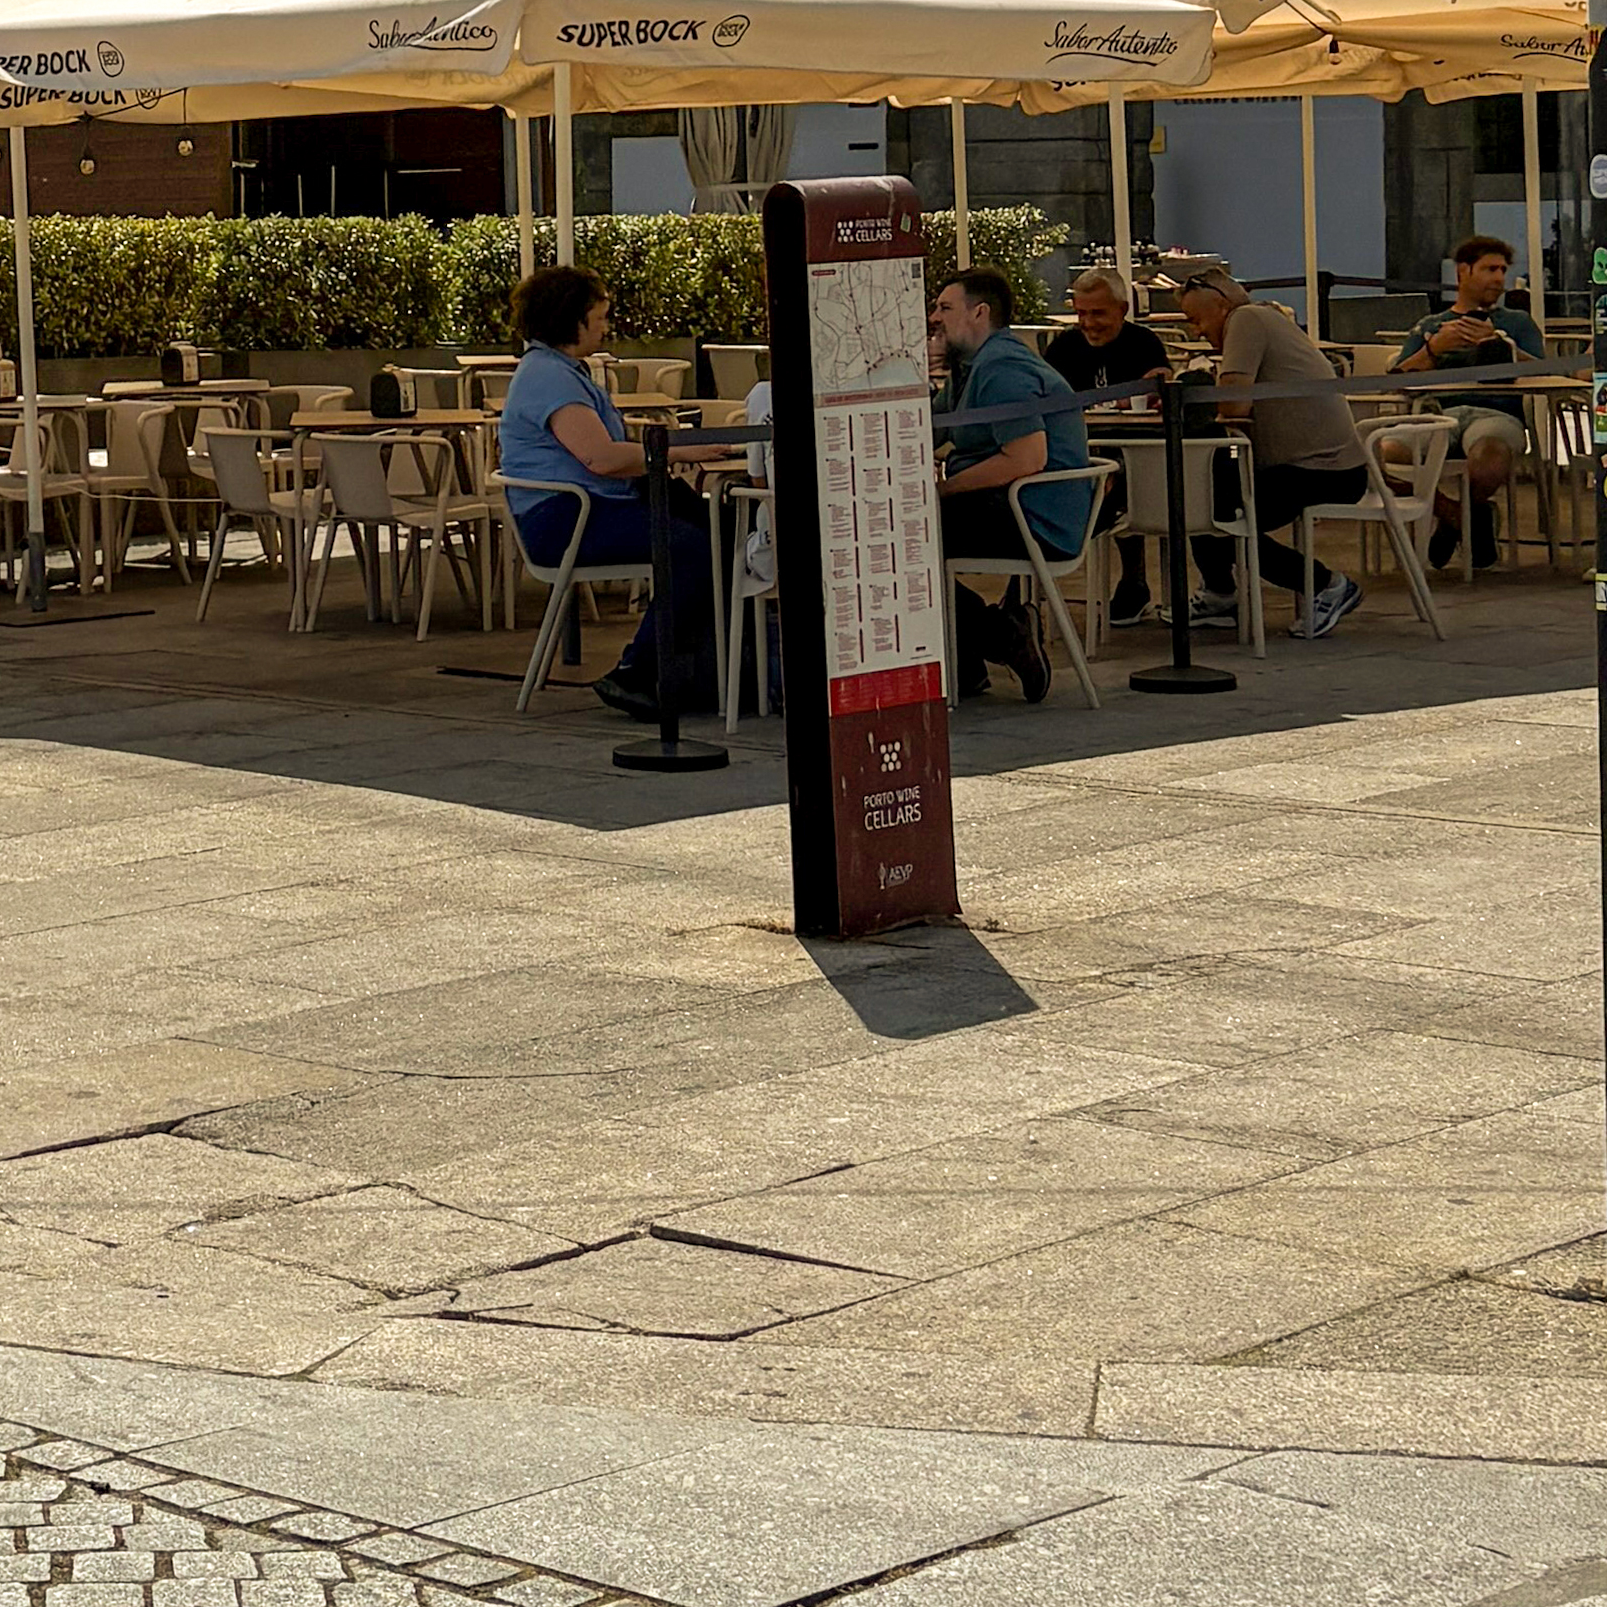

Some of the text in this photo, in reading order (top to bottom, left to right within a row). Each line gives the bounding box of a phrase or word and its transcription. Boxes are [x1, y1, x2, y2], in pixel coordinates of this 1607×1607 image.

[556, 20, 633, 49] SUPER
[636, 19, 707, 44] BOCK
[1044, 20, 1100, 50] Sabor
[35, 49, 92, 75] BOCK
[855, 228, 893, 242] CELLARS
[863, 785, 921, 809] PORTO WINE
[864, 803, 922, 831] CELLARS
